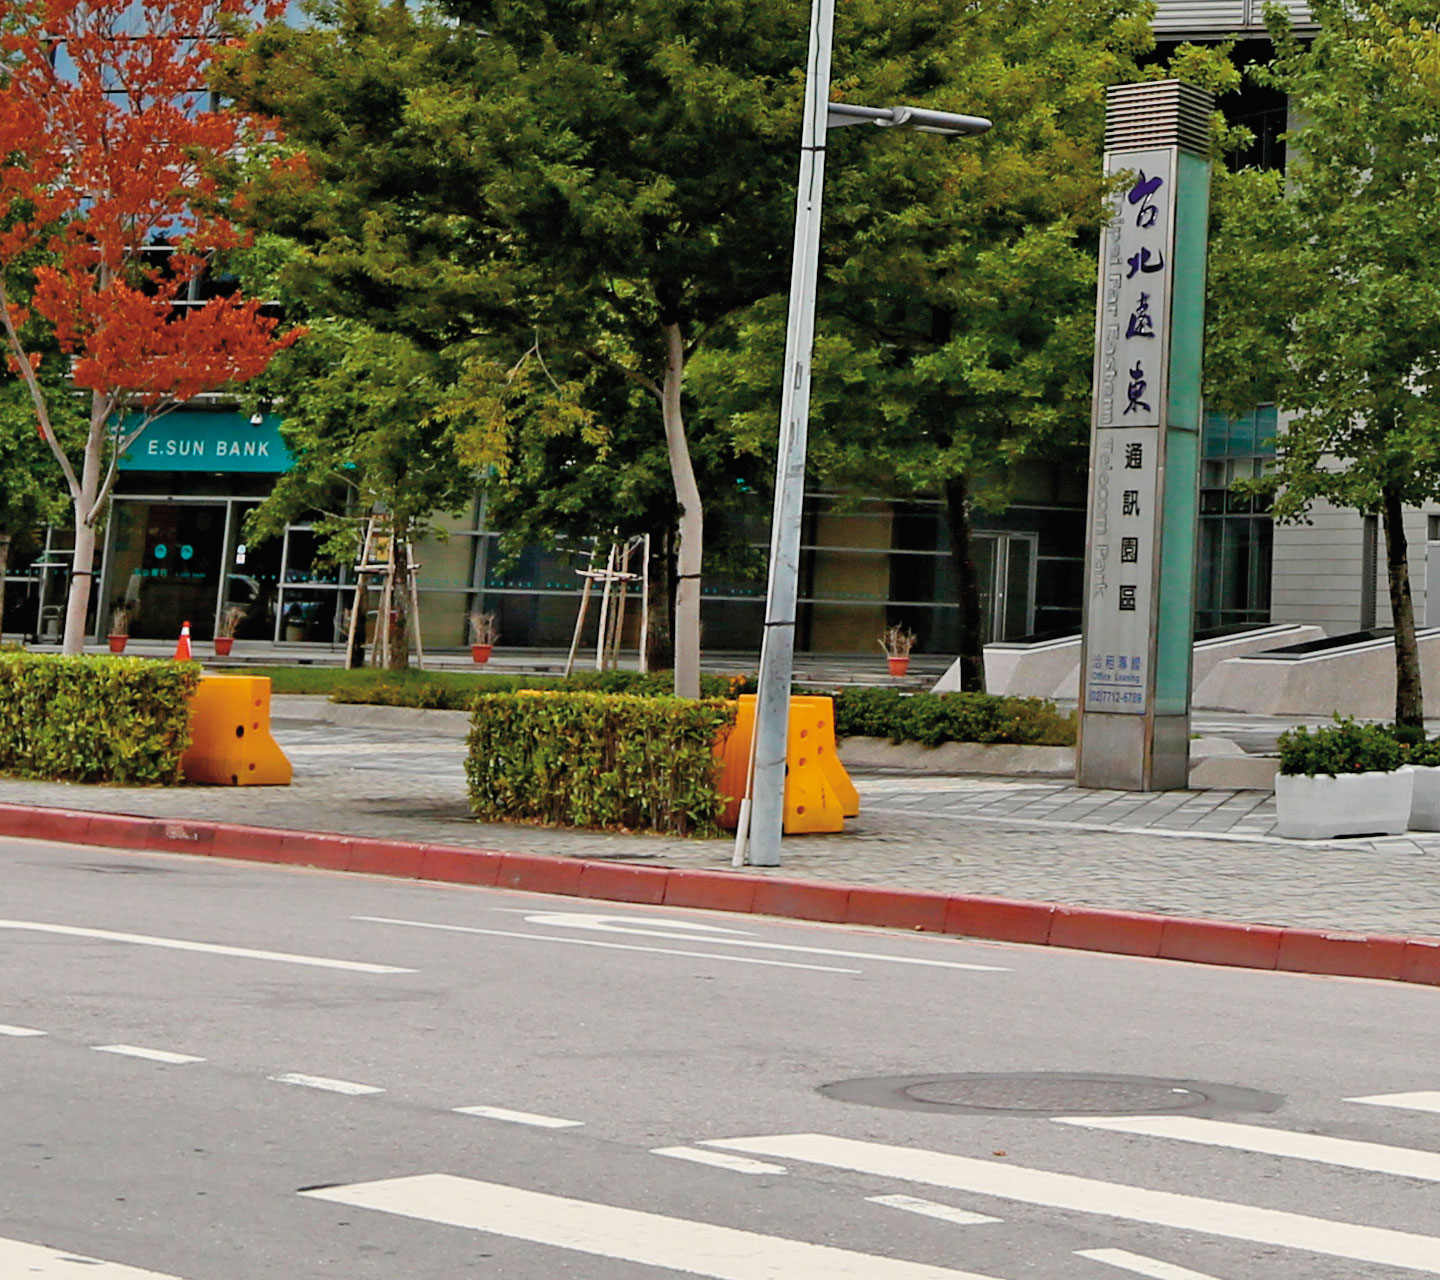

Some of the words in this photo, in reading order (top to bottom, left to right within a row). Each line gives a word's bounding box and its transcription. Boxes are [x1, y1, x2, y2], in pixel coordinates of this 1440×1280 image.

[1106, 273, 1122, 316] Far
[1101, 324, 1120, 425] Eastern
[148, 440, 205, 456] E.SUN
[216, 441, 270, 457] BANK
[1096, 437, 1114, 536] Telecom
[1119, 443, 1143, 611] 通訊園區
[1093, 544, 1109, 599] Park
